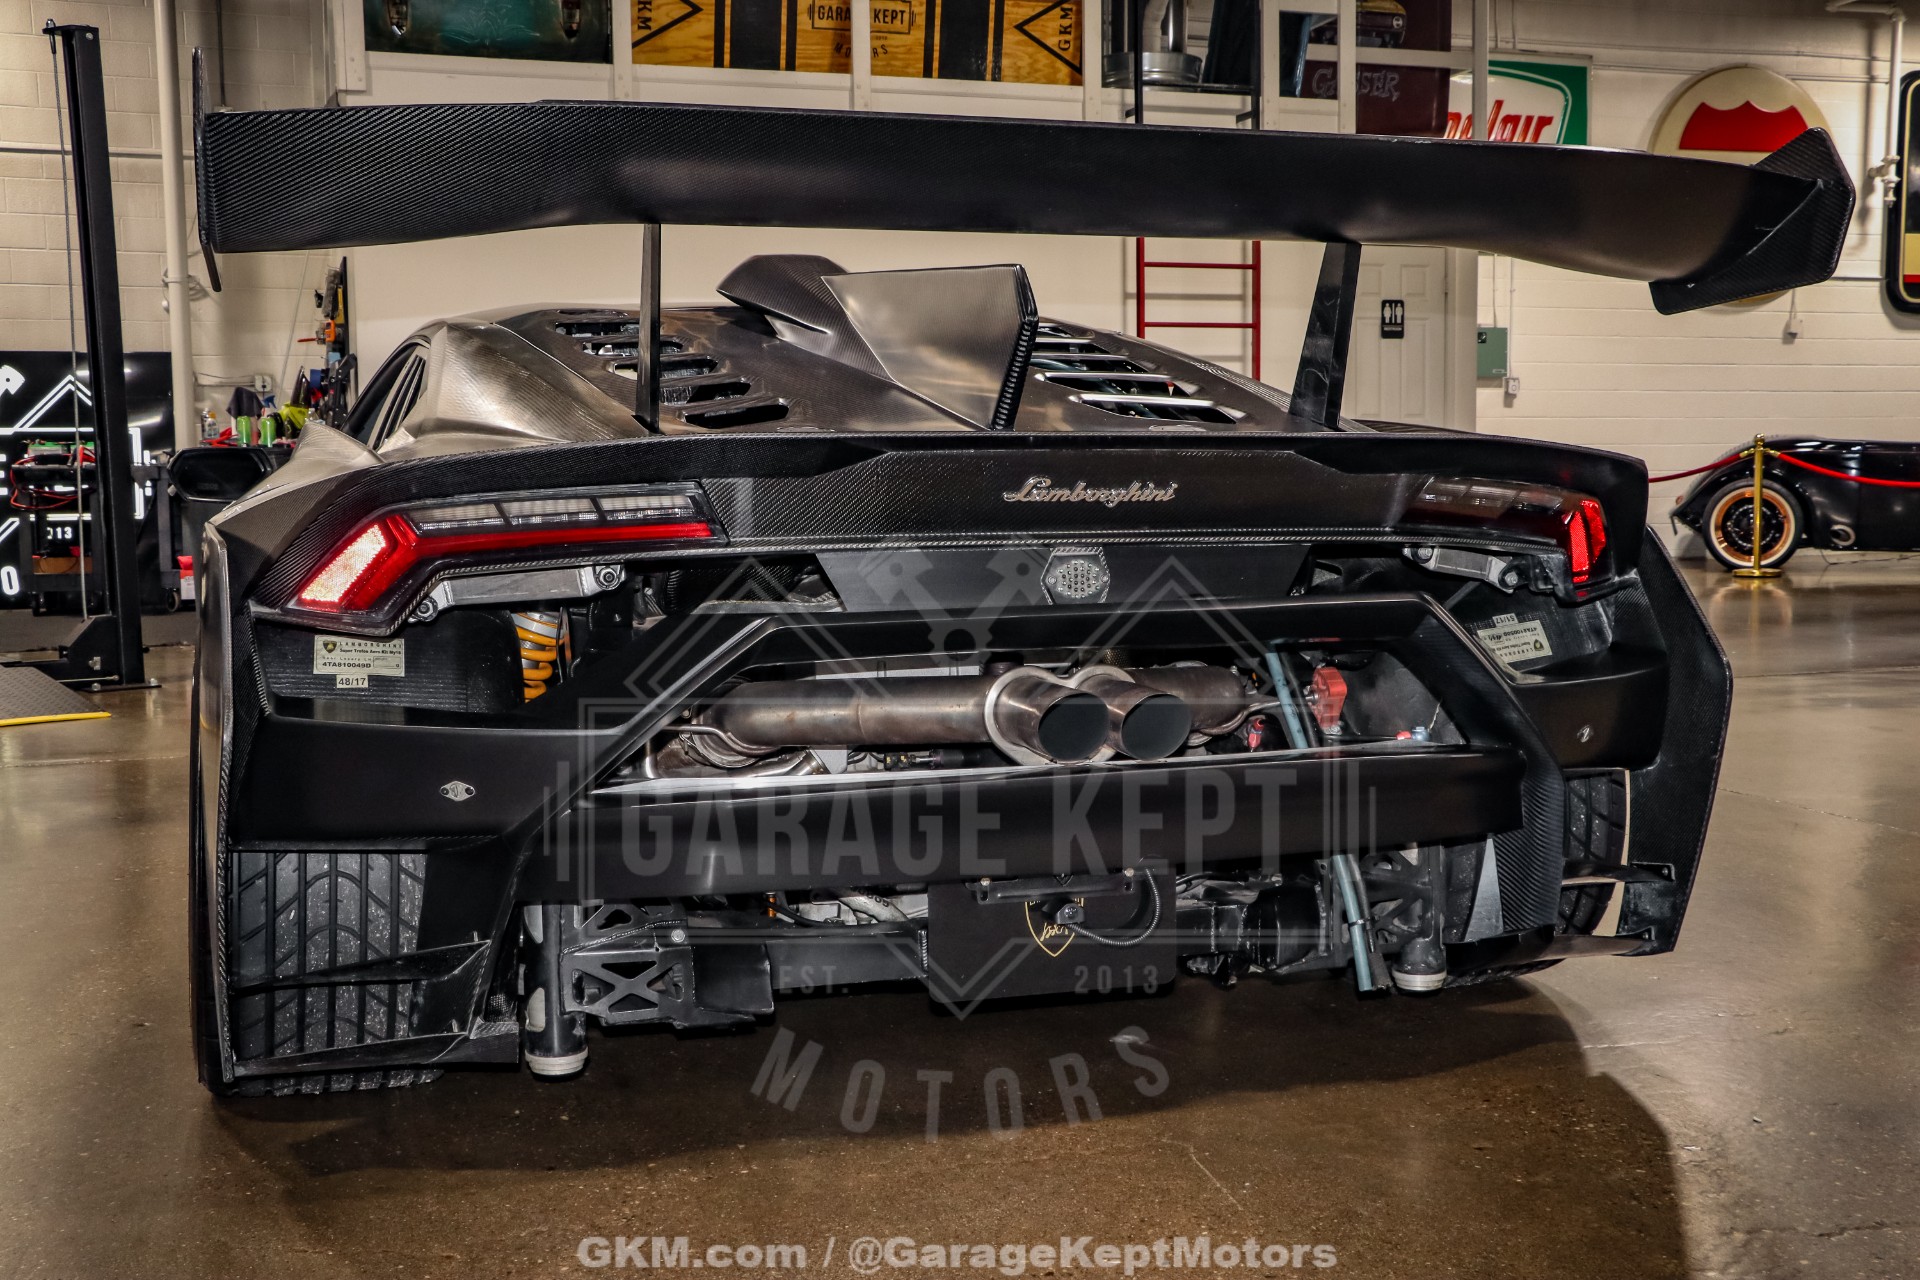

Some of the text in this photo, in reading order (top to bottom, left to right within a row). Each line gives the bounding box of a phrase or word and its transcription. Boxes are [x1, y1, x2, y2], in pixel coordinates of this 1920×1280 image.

[637, 0, 652, 31] KM
[817, 5, 906, 25] GARA KEPT
[1058, 7, 1073, 51] GKM
[1002, 475, 1178, 508] Lamborghini
[338, 677, 366, 686] 48/17
